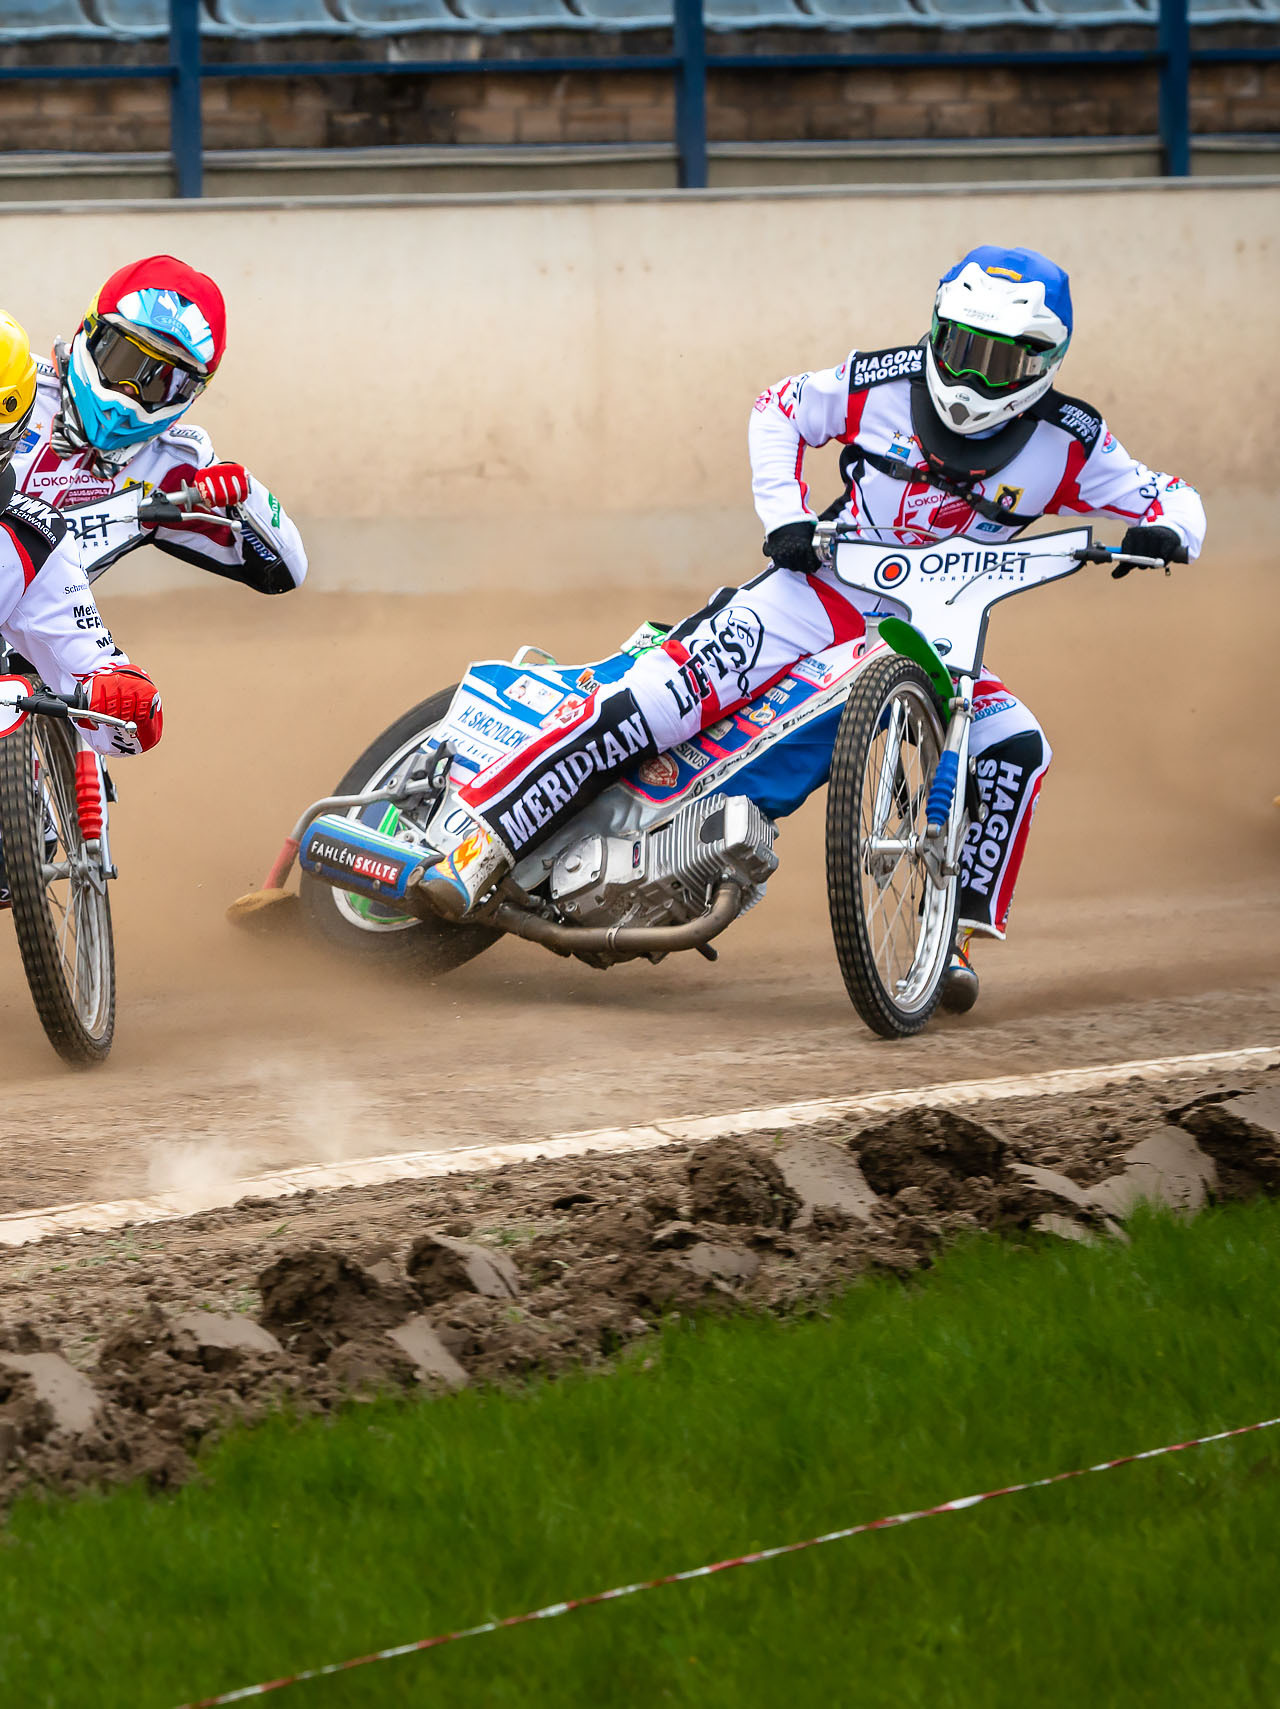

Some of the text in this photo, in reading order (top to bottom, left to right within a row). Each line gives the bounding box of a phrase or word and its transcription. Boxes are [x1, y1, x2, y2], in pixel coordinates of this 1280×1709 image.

[854, 361, 922, 386] SHOCKS
[855, 350, 923, 374] HAGON
[11, 507, 57, 545] SCHWAIGER
[920, 552, 1031, 574] OPTIBET
[665, 625, 747, 719] LIFTS
[499, 711, 650, 851] MERIDIAN
[970, 760, 1024, 895] HAGON
